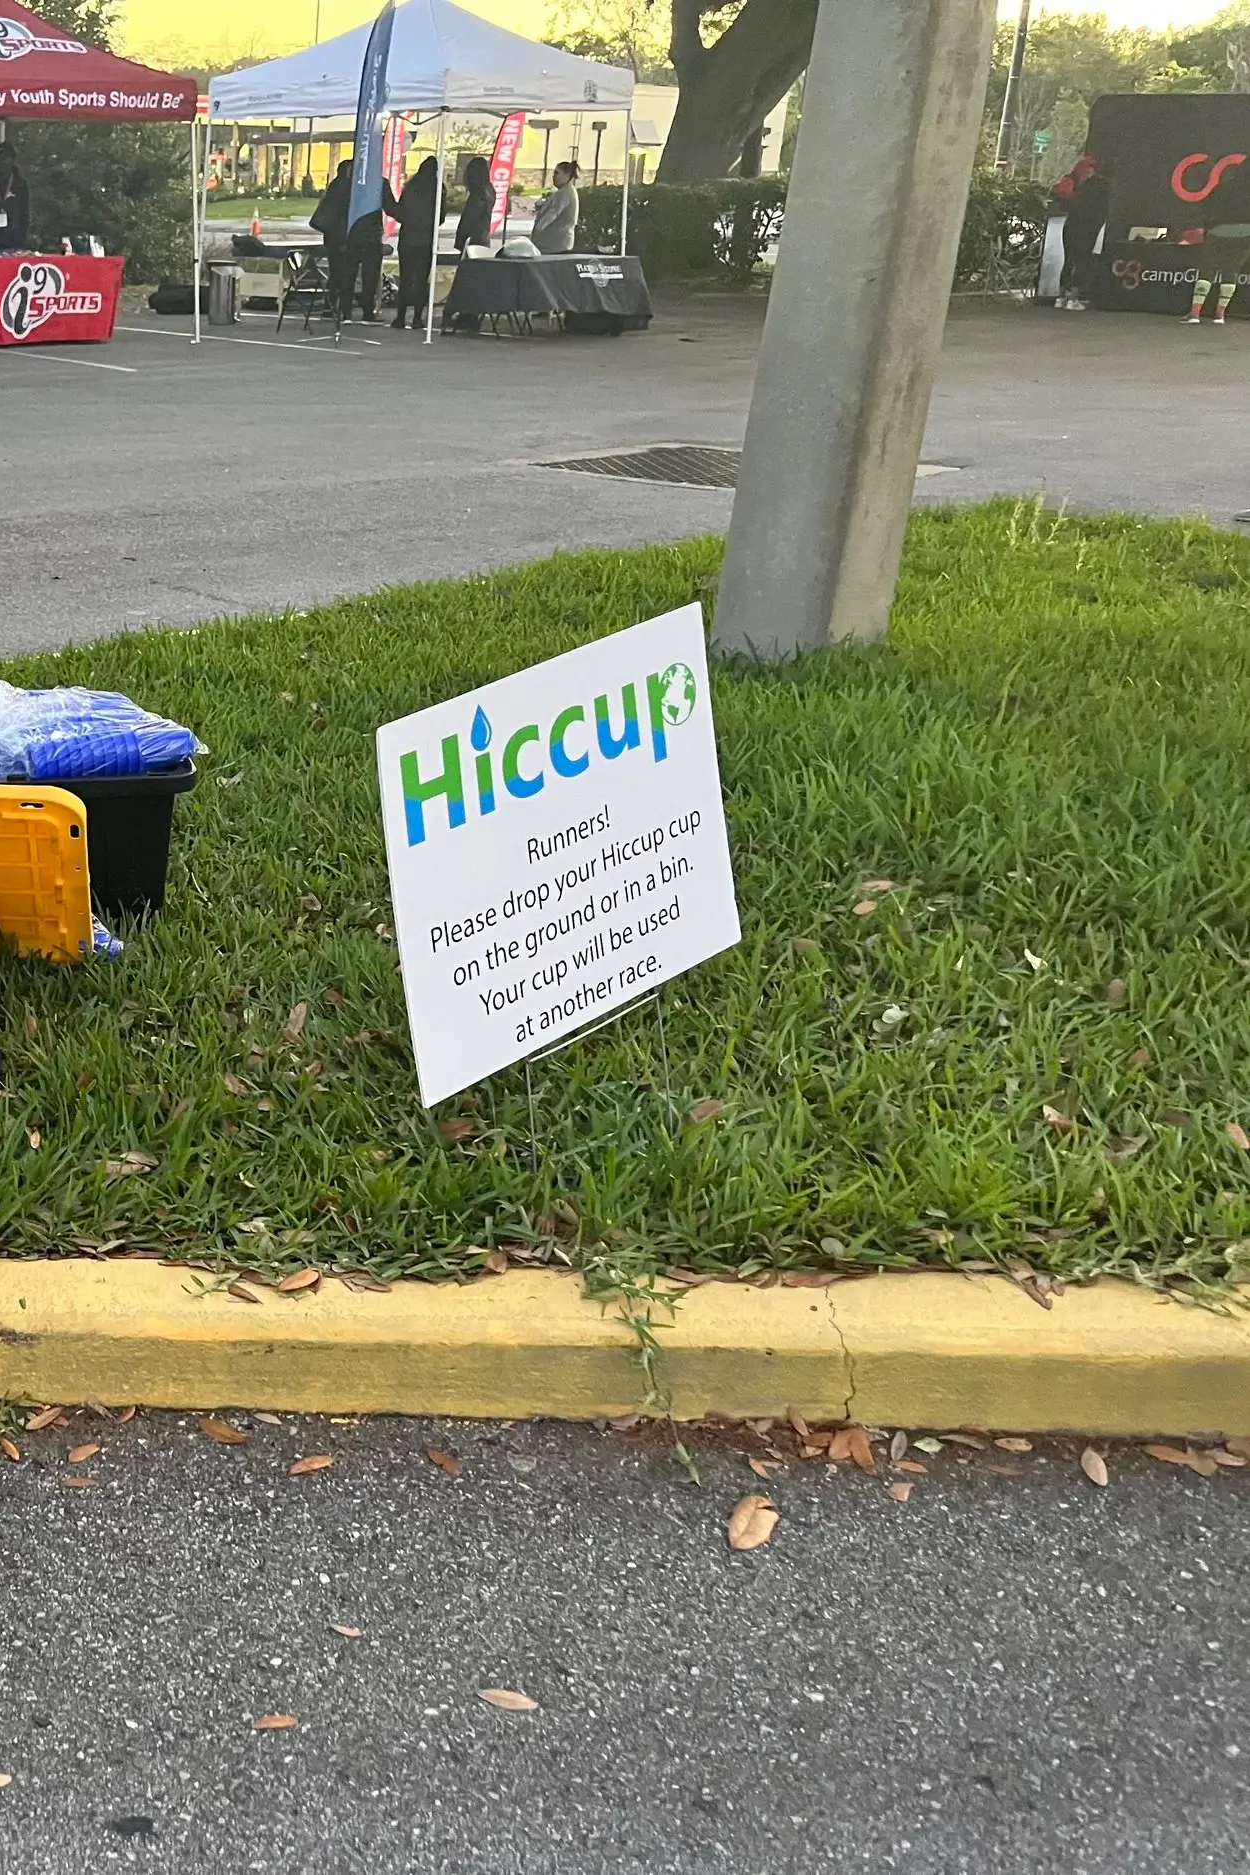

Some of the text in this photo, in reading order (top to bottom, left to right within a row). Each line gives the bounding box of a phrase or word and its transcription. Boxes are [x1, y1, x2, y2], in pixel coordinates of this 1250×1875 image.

[2, 38, 84, 52] SPORTS
[10, 89, 55, 105] Youth
[58, 89, 106, 110] Sports
[109, 91, 159, 108] Should
[498, 119, 521, 163] NEW
[28, 295, 99, 318] SPORTS
[400, 662, 697, 848] Hiccup
[527, 804, 610, 864] Runners!
[430, 810, 701, 954] Please drop your Hiccup cup
[453, 857, 694, 986] on the ground or in a bin.
[478, 894, 680, 1016] Your cup will be used
[516, 955, 662, 1043] at another race.
